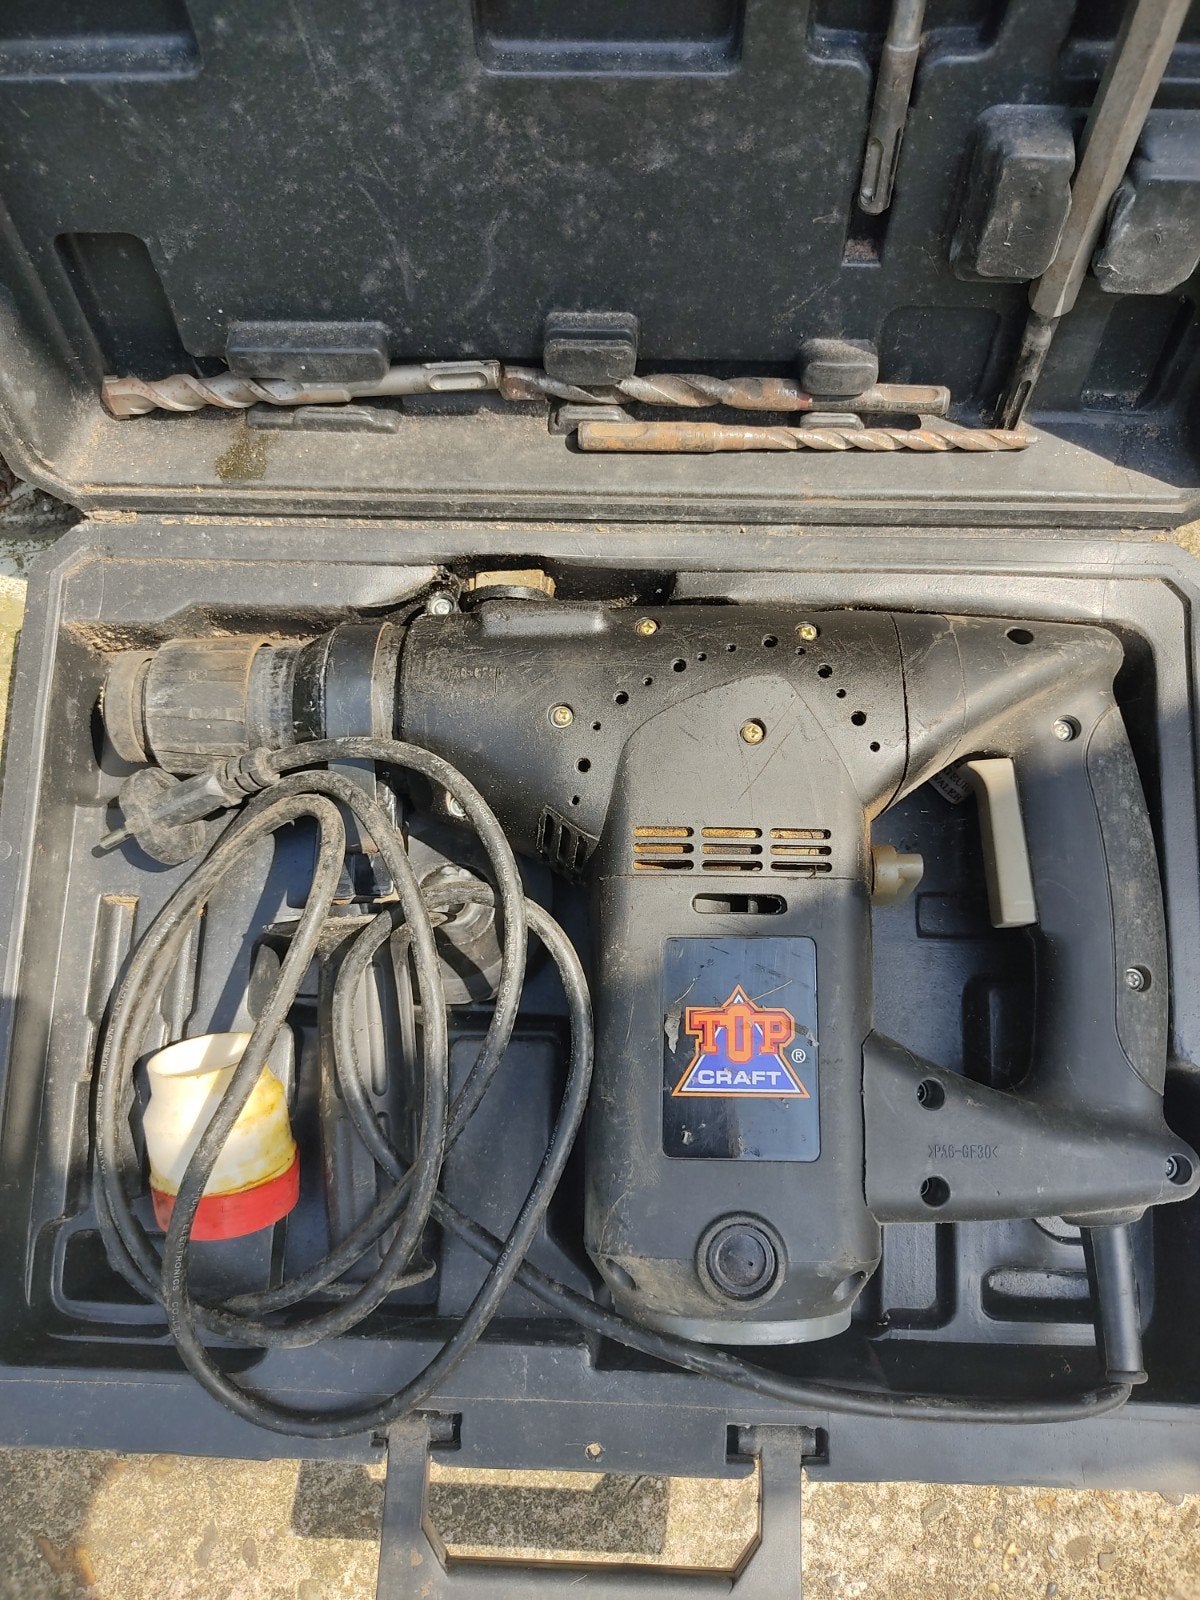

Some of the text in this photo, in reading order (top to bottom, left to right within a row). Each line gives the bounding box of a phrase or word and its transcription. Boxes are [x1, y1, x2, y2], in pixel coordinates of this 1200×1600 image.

[690, 1001, 794, 1064] TOP
[697, 1069, 782, 1085] CRAFT
[172, 1223, 190, 1291] ELECTRONICS
